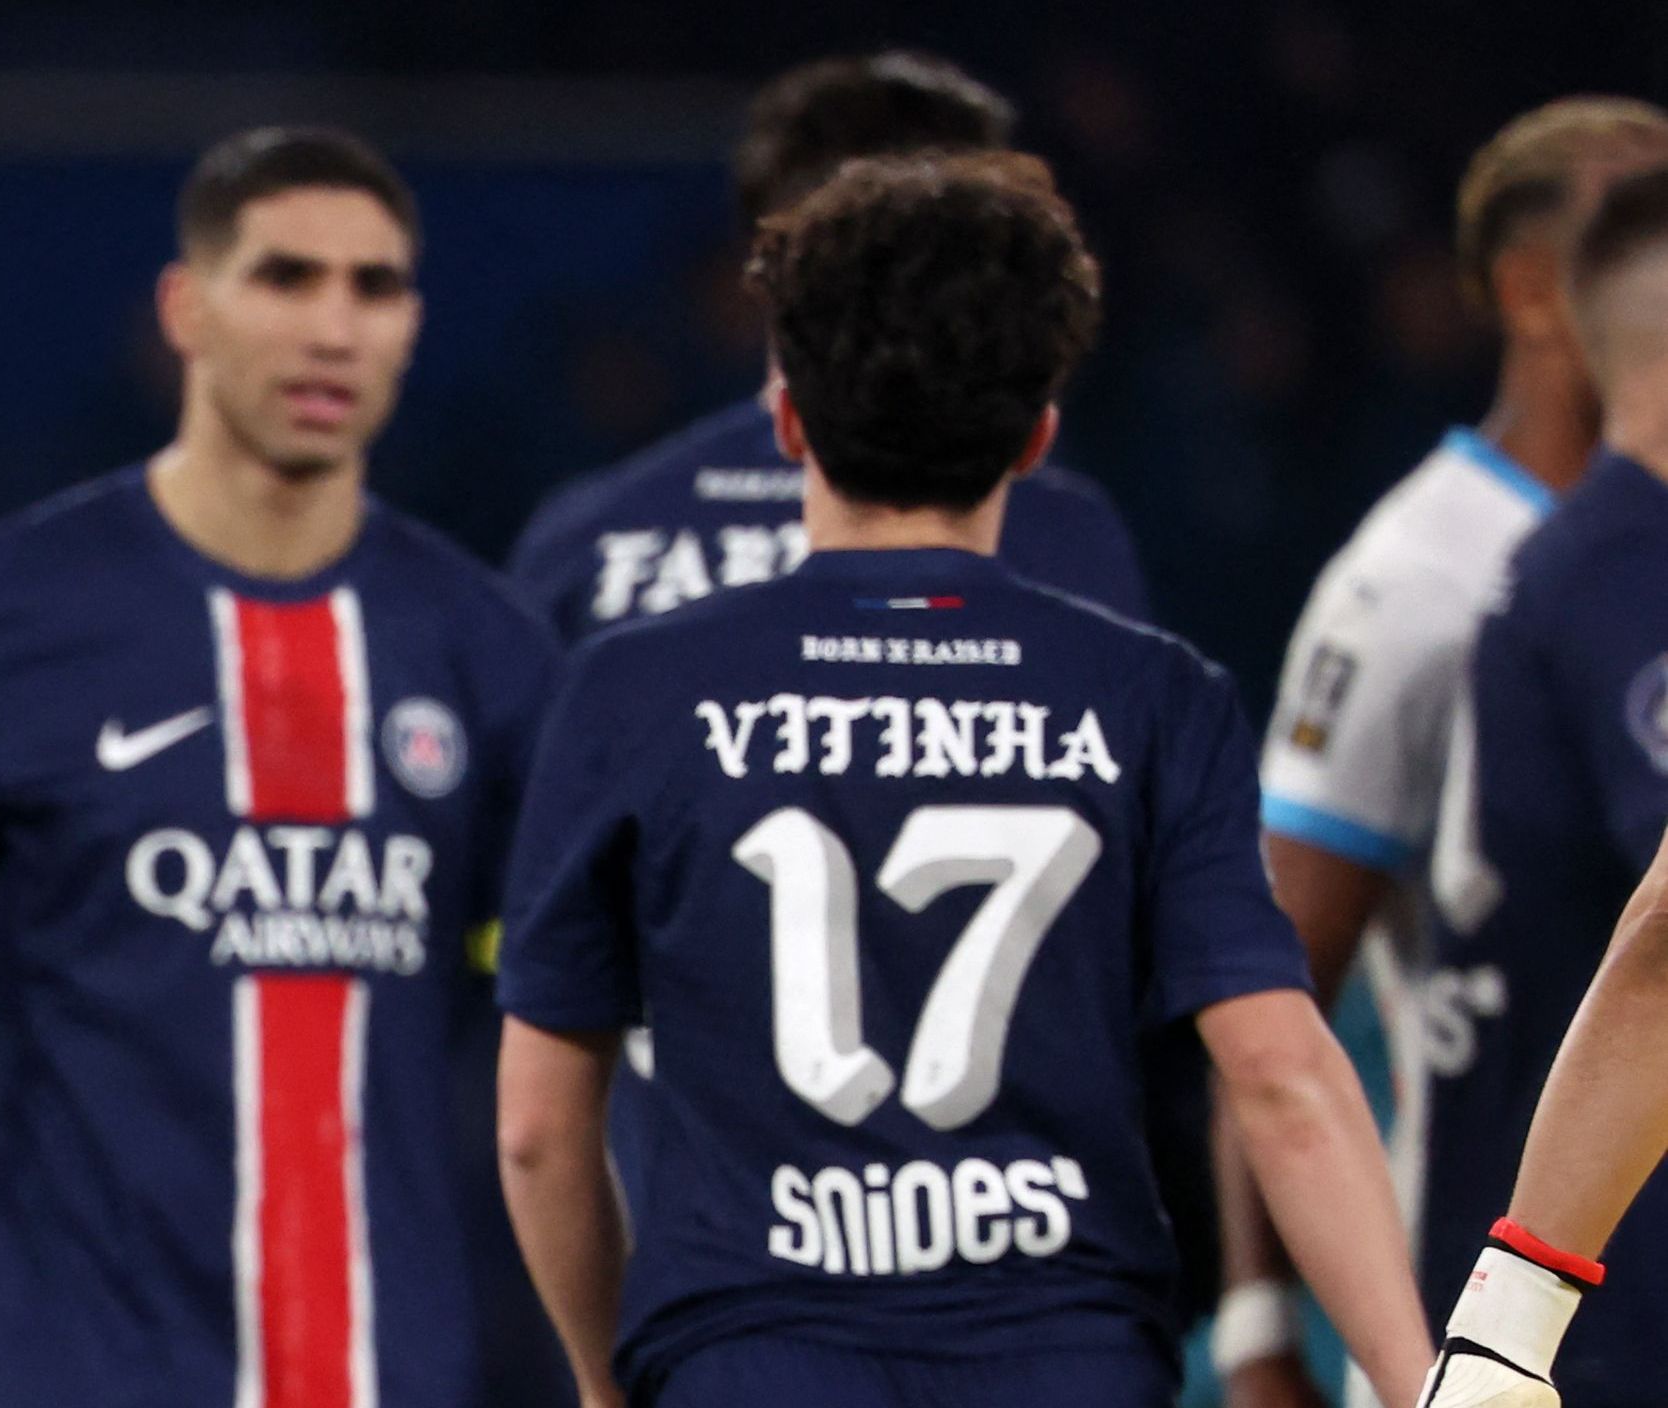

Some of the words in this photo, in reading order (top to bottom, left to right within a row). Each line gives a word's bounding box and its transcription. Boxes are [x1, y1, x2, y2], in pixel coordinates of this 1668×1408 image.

[695, 691, 1122, 784] VITINHA
[125, 824, 433, 932] QATAR
[731, 805, 1102, 1131] 17
